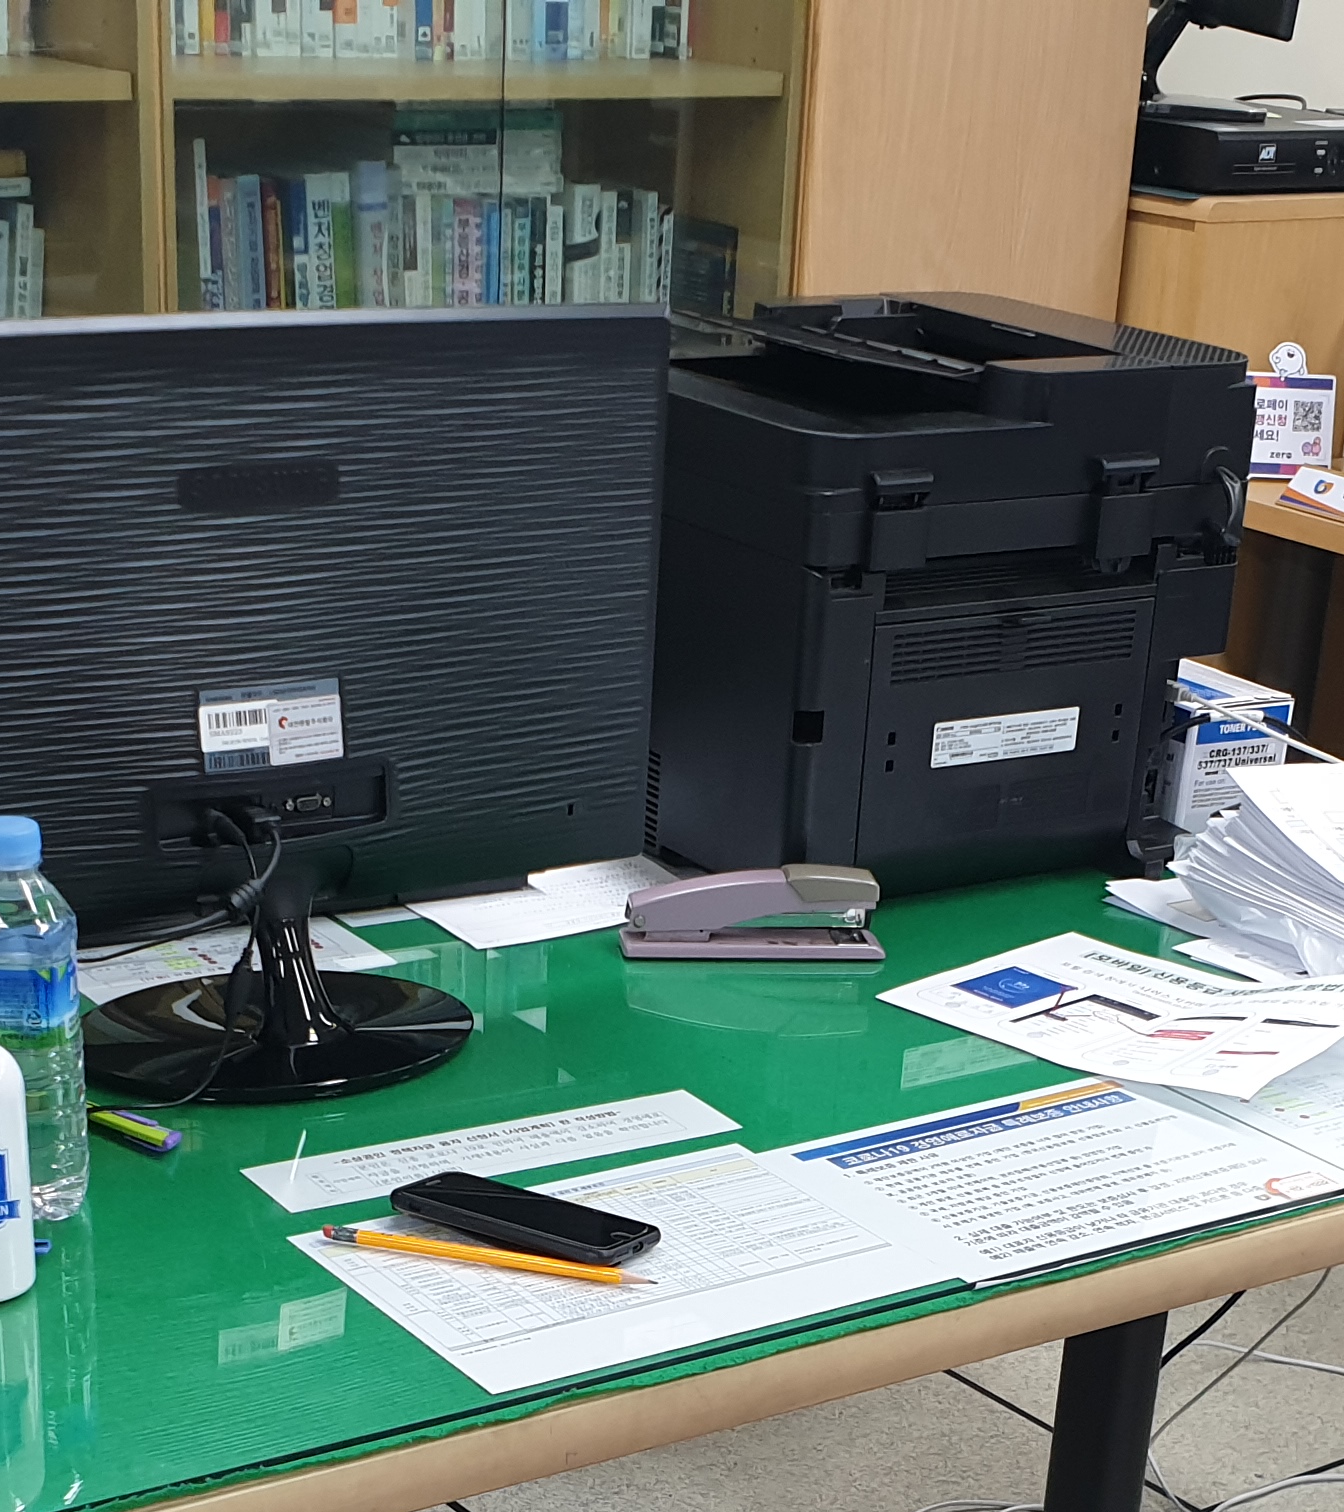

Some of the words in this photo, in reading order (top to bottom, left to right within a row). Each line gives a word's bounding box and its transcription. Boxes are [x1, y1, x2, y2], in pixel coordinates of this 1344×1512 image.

[1219, 722, 1246, 735] TONER
[1235, 754, 1276, 767] Universal
[839, 1143, 913, 1166] 코로나19
[907, 1122, 1004, 1150] 경영애로자금
